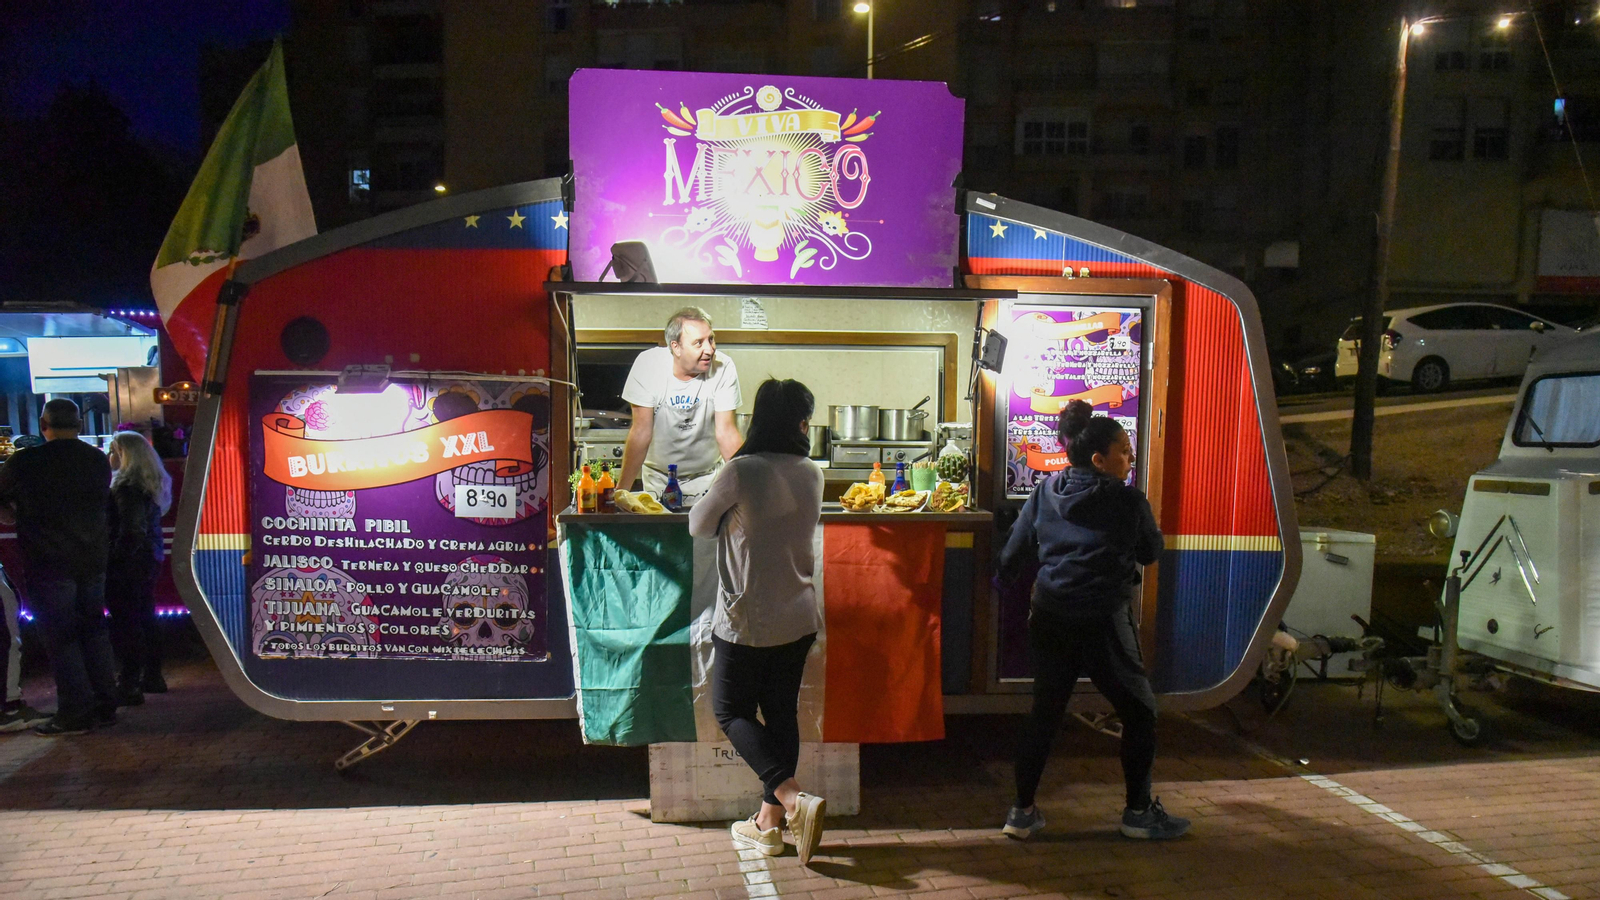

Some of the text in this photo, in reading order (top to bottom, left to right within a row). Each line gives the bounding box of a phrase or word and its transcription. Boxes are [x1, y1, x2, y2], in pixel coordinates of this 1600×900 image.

[736, 113, 801, 136] VIVA
[662, 137, 872, 210] MEXICO
[158, 389, 201, 403] COFF
[287, 431, 495, 478] BUROS XXL
[261, 516, 411, 533] COCHINITA PIBIL
[262, 534, 312, 547] CERDO
[427, 538, 437, 550] Y
[439, 539, 485, 551] CREMA
[487, 540, 527, 552] AGRIA
[262, 554, 529, 575] JALISCO TERNERA Y QUESO CHEDDAR
[264, 577, 500, 597] SINALOA POLLO Y GUACAMOLE
[264, 600, 537, 620] TIJUANA GUACAMOLE VERDURITAS
[264, 620, 276, 632] Y
[280, 621, 366, 635] PIMIENTOS
[379, 623, 451, 636] COLORES
[306, 642, 327, 651] LOS
[328, 643, 382, 653] BURRITOS
[384, 644, 406, 654] VAN
[432, 645, 453, 654] MIX
